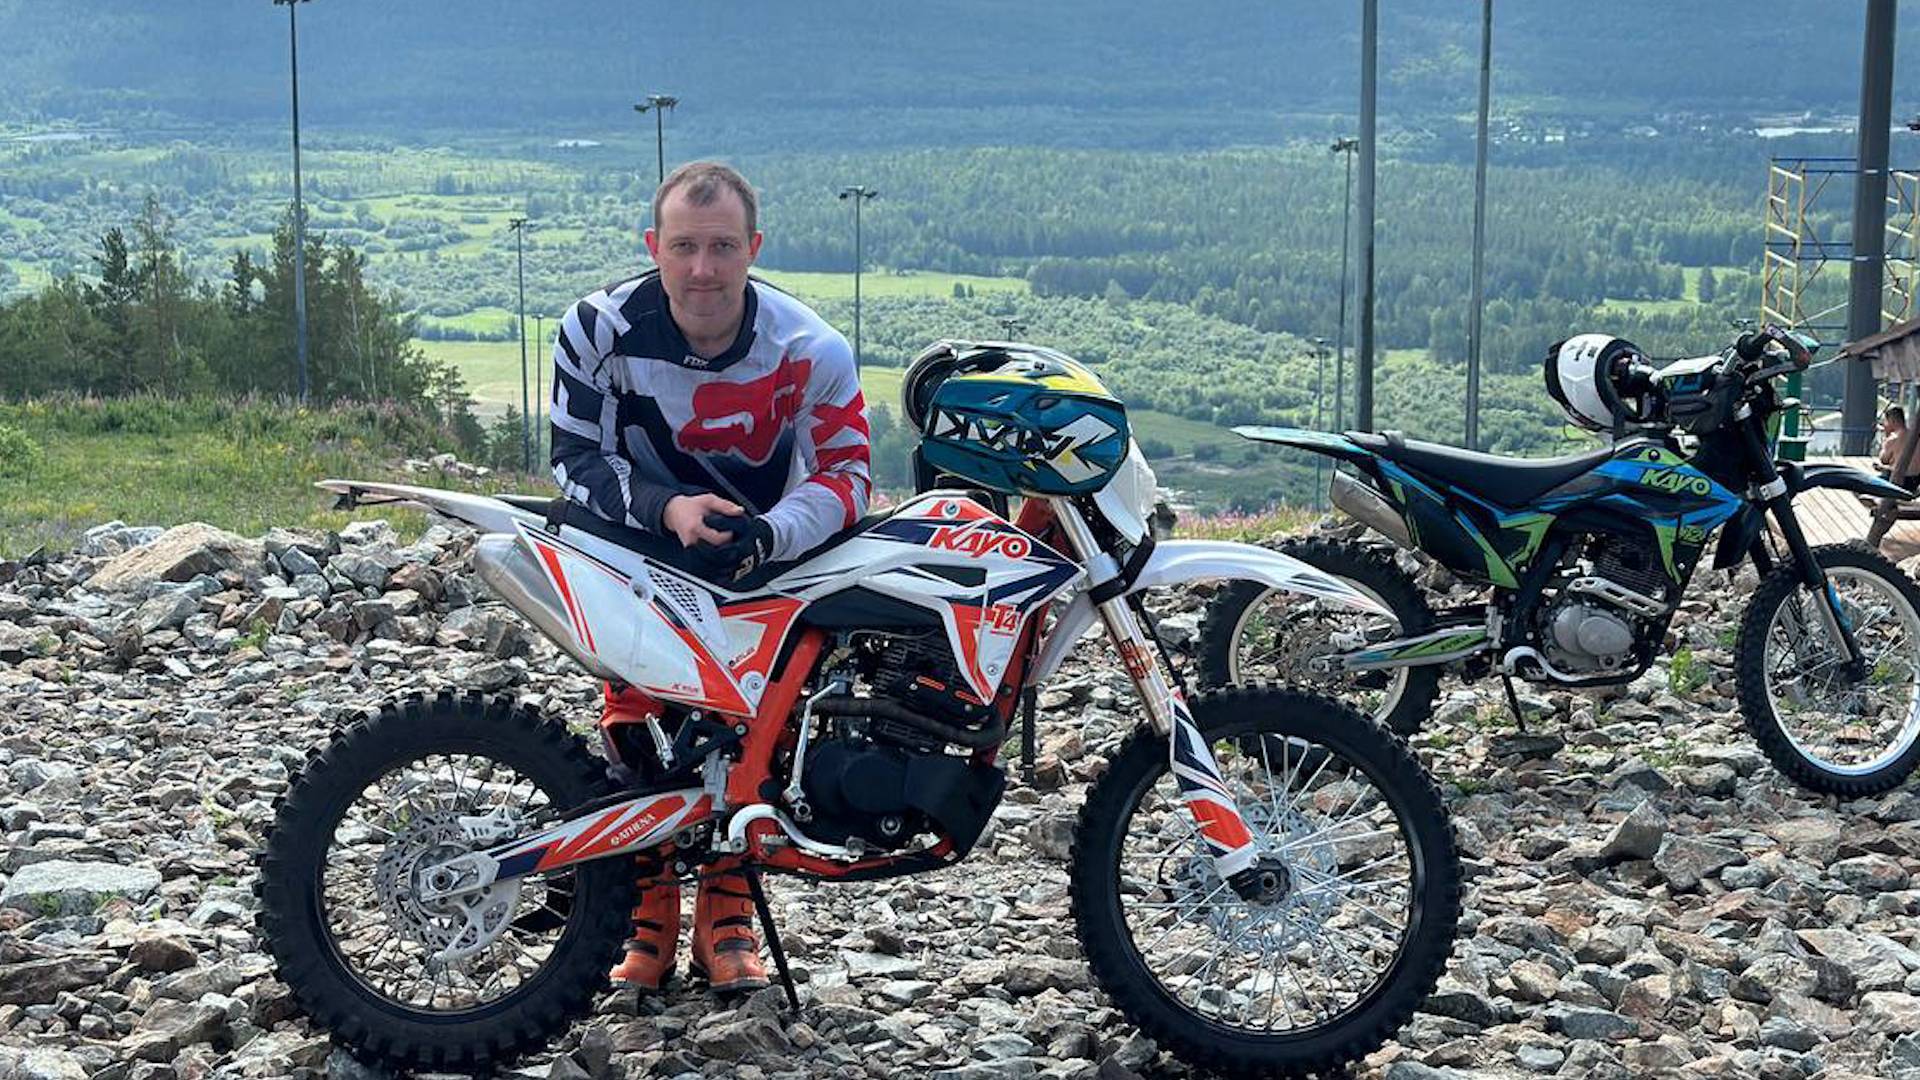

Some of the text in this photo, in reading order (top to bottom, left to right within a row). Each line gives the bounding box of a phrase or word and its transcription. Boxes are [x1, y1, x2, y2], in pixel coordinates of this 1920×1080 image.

[683, 355, 709, 369] FOX
[1641, 468, 1710, 495] KAYO
[929, 526, 1029, 559] KAYO
[993, 604, 1018, 631] T4
